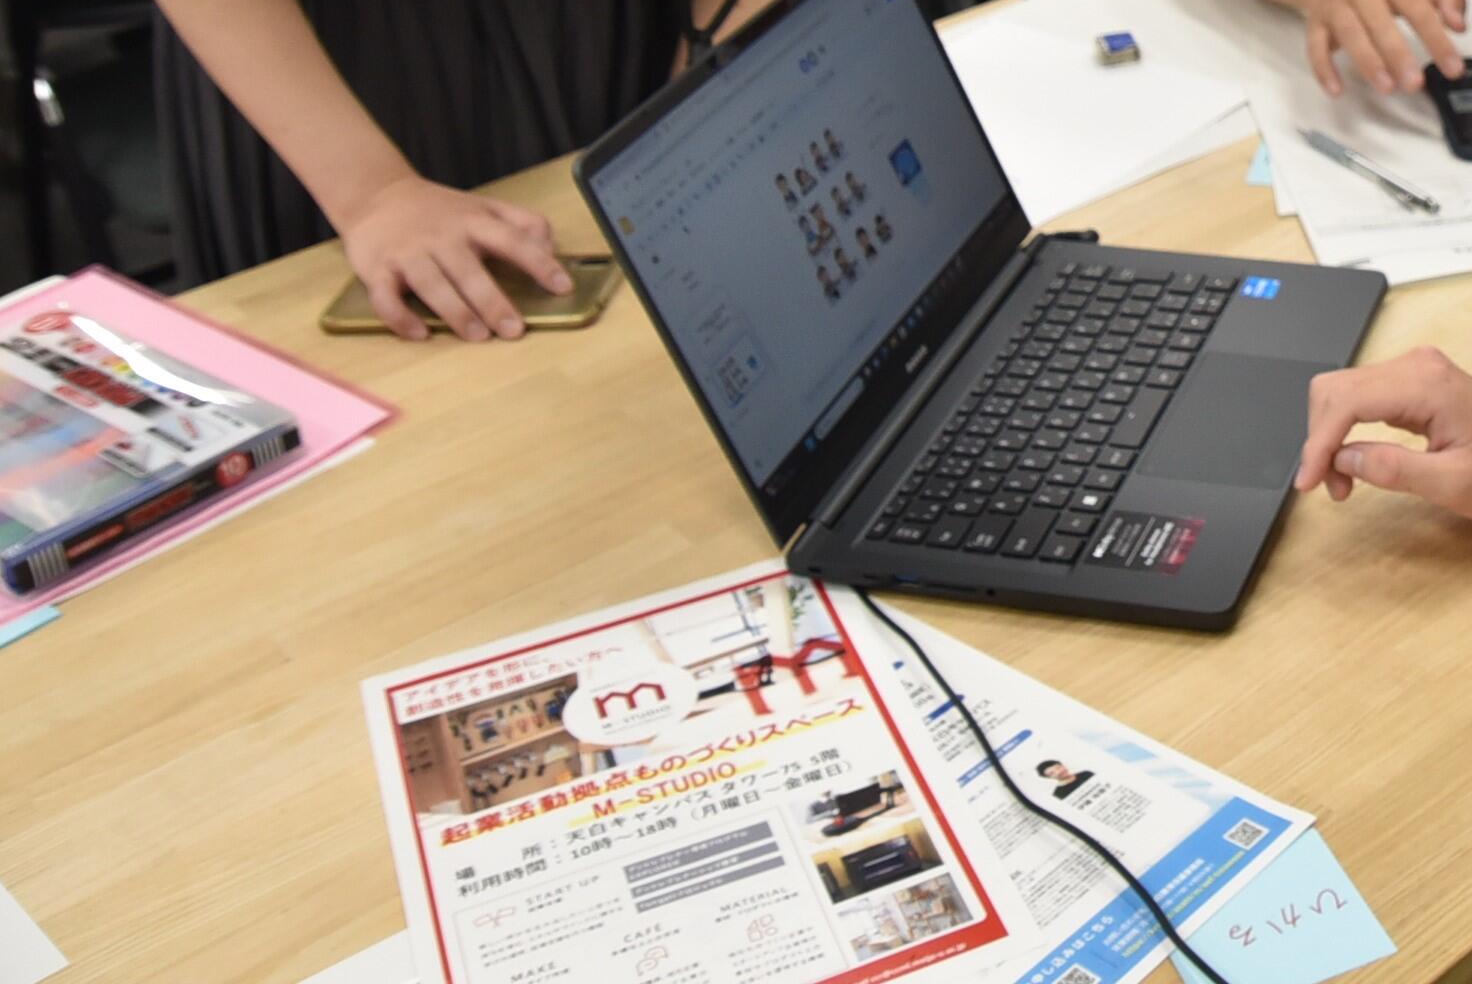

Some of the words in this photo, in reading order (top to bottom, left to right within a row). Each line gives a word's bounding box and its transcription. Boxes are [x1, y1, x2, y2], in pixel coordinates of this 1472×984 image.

[440, 698, 865, 847] 起業活動拠点ものづくりスペース
[592, 761, 737, 820] M-STUDIO
[1025, 916, 1115, 983] 申し込みはこちら
